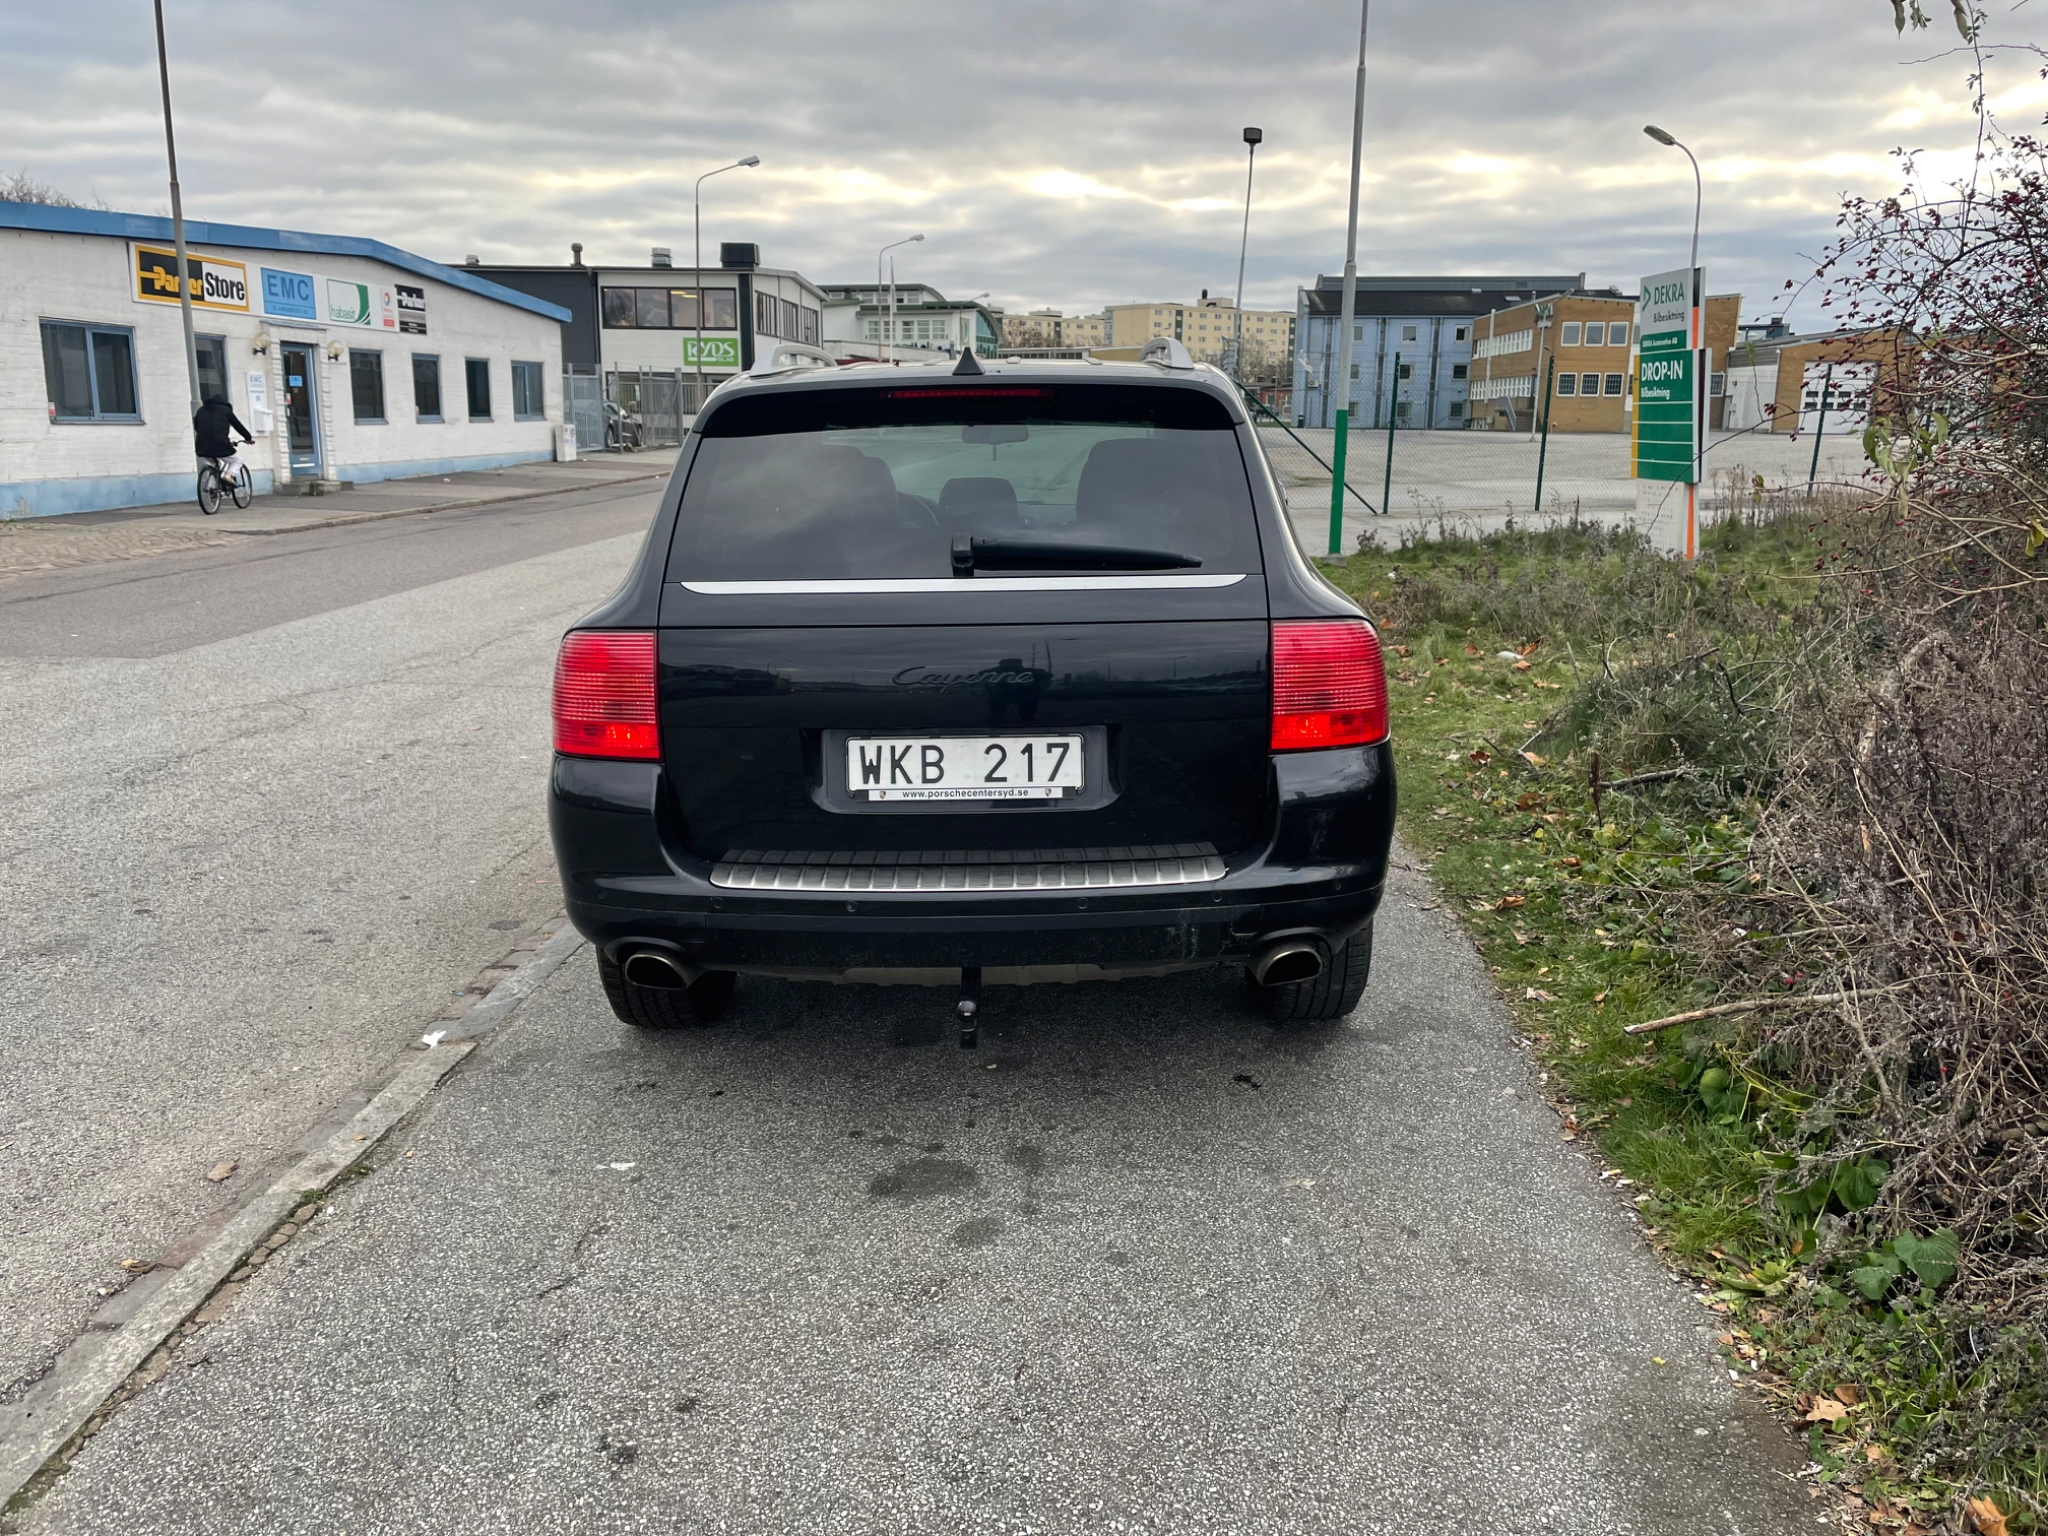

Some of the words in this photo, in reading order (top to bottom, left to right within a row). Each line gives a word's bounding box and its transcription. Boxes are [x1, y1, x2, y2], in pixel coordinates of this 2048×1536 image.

[152, 265, 203, 296] Parer
[204, 271, 245, 301] Store
[266, 274, 310, 301] EMC
[1654, 282, 1685, 305] DEKRA
[330, 304, 356, 320] habasit
[1653, 310, 1685, 323] Bilbesiktning
[687, 341, 735, 357] RYDS
[1641, 360, 1683, 382] DROP-IN
[1640, 387, 1670, 400] Bilbesiktning
[892, 666, 1034, 694] Cayenne
[859, 744, 945, 785] WKB
[984, 742, 1070, 784] 217
[902, 787, 1029, 799] www.porschecentersyd.se
